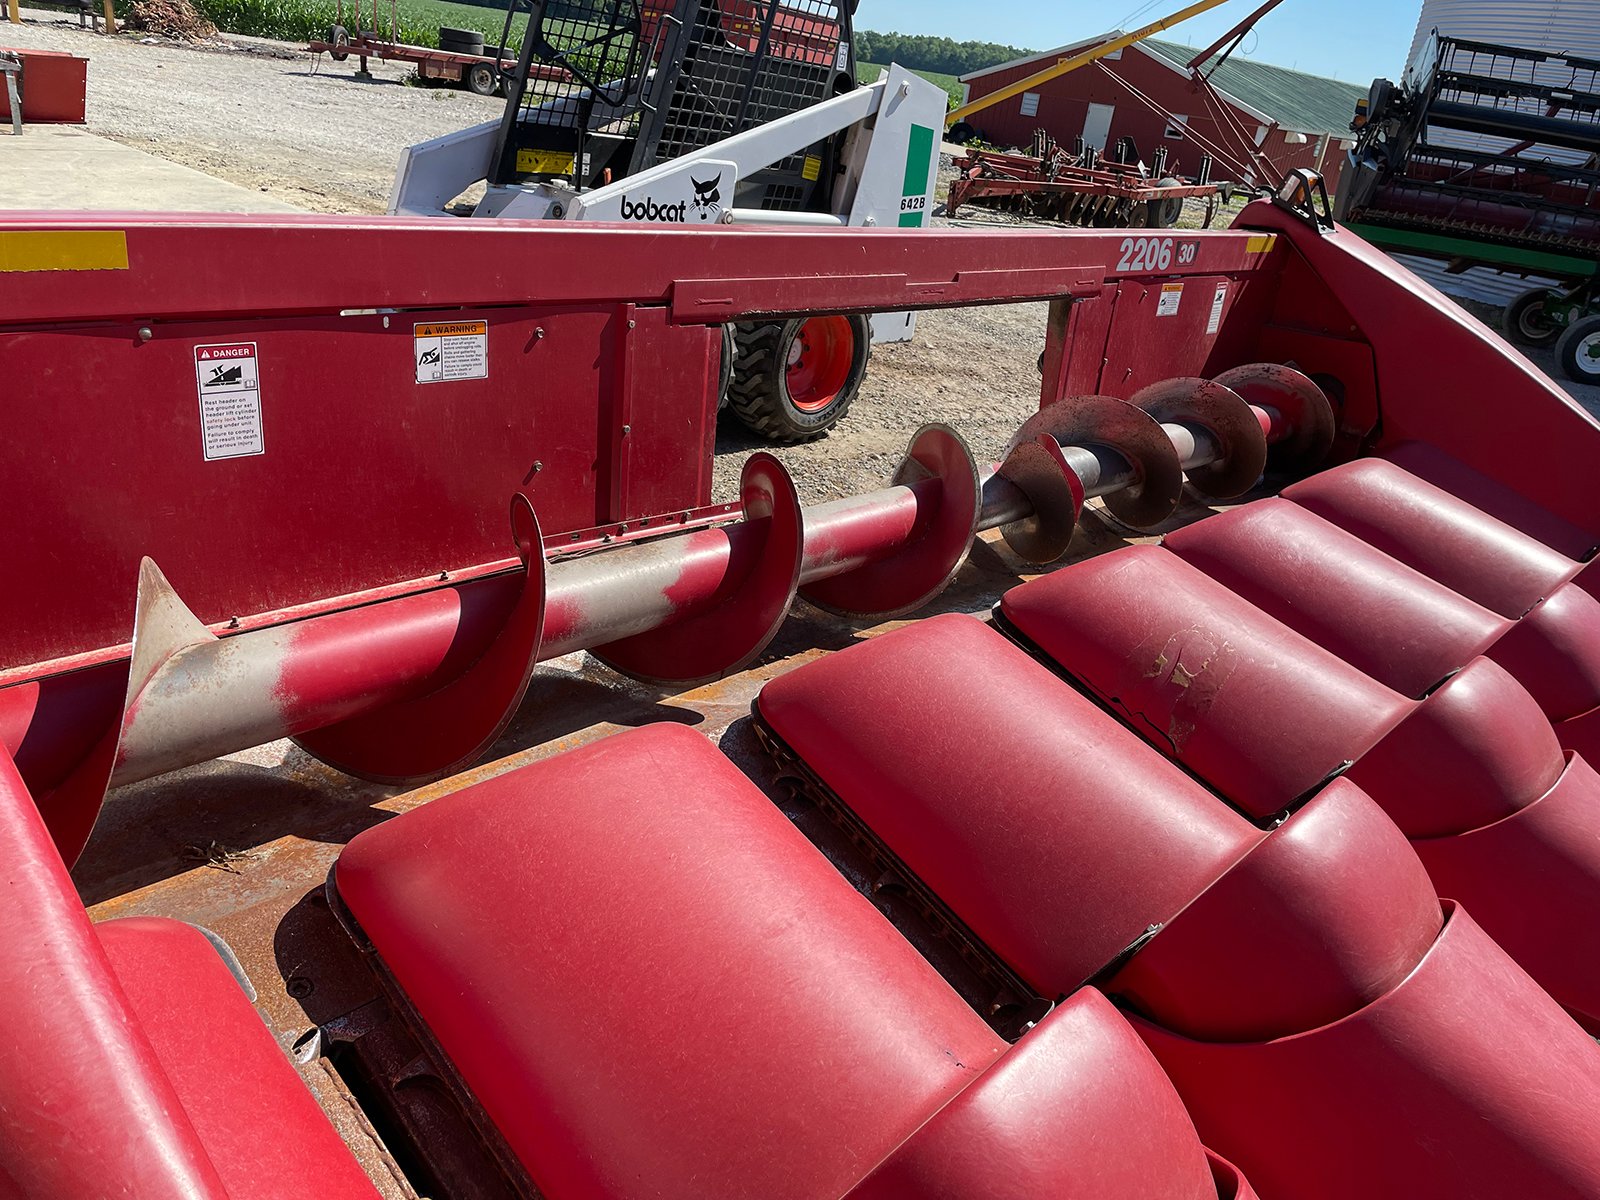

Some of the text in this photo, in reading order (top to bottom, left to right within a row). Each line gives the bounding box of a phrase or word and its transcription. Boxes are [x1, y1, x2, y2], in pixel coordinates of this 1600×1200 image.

[621, 195, 686, 222] bobcat
[900, 197, 925, 210] 642B
[1116, 237, 1195, 271] 2206 30
[436, 325, 477, 333] WARNING
[213, 348, 250, 358] DANGER
